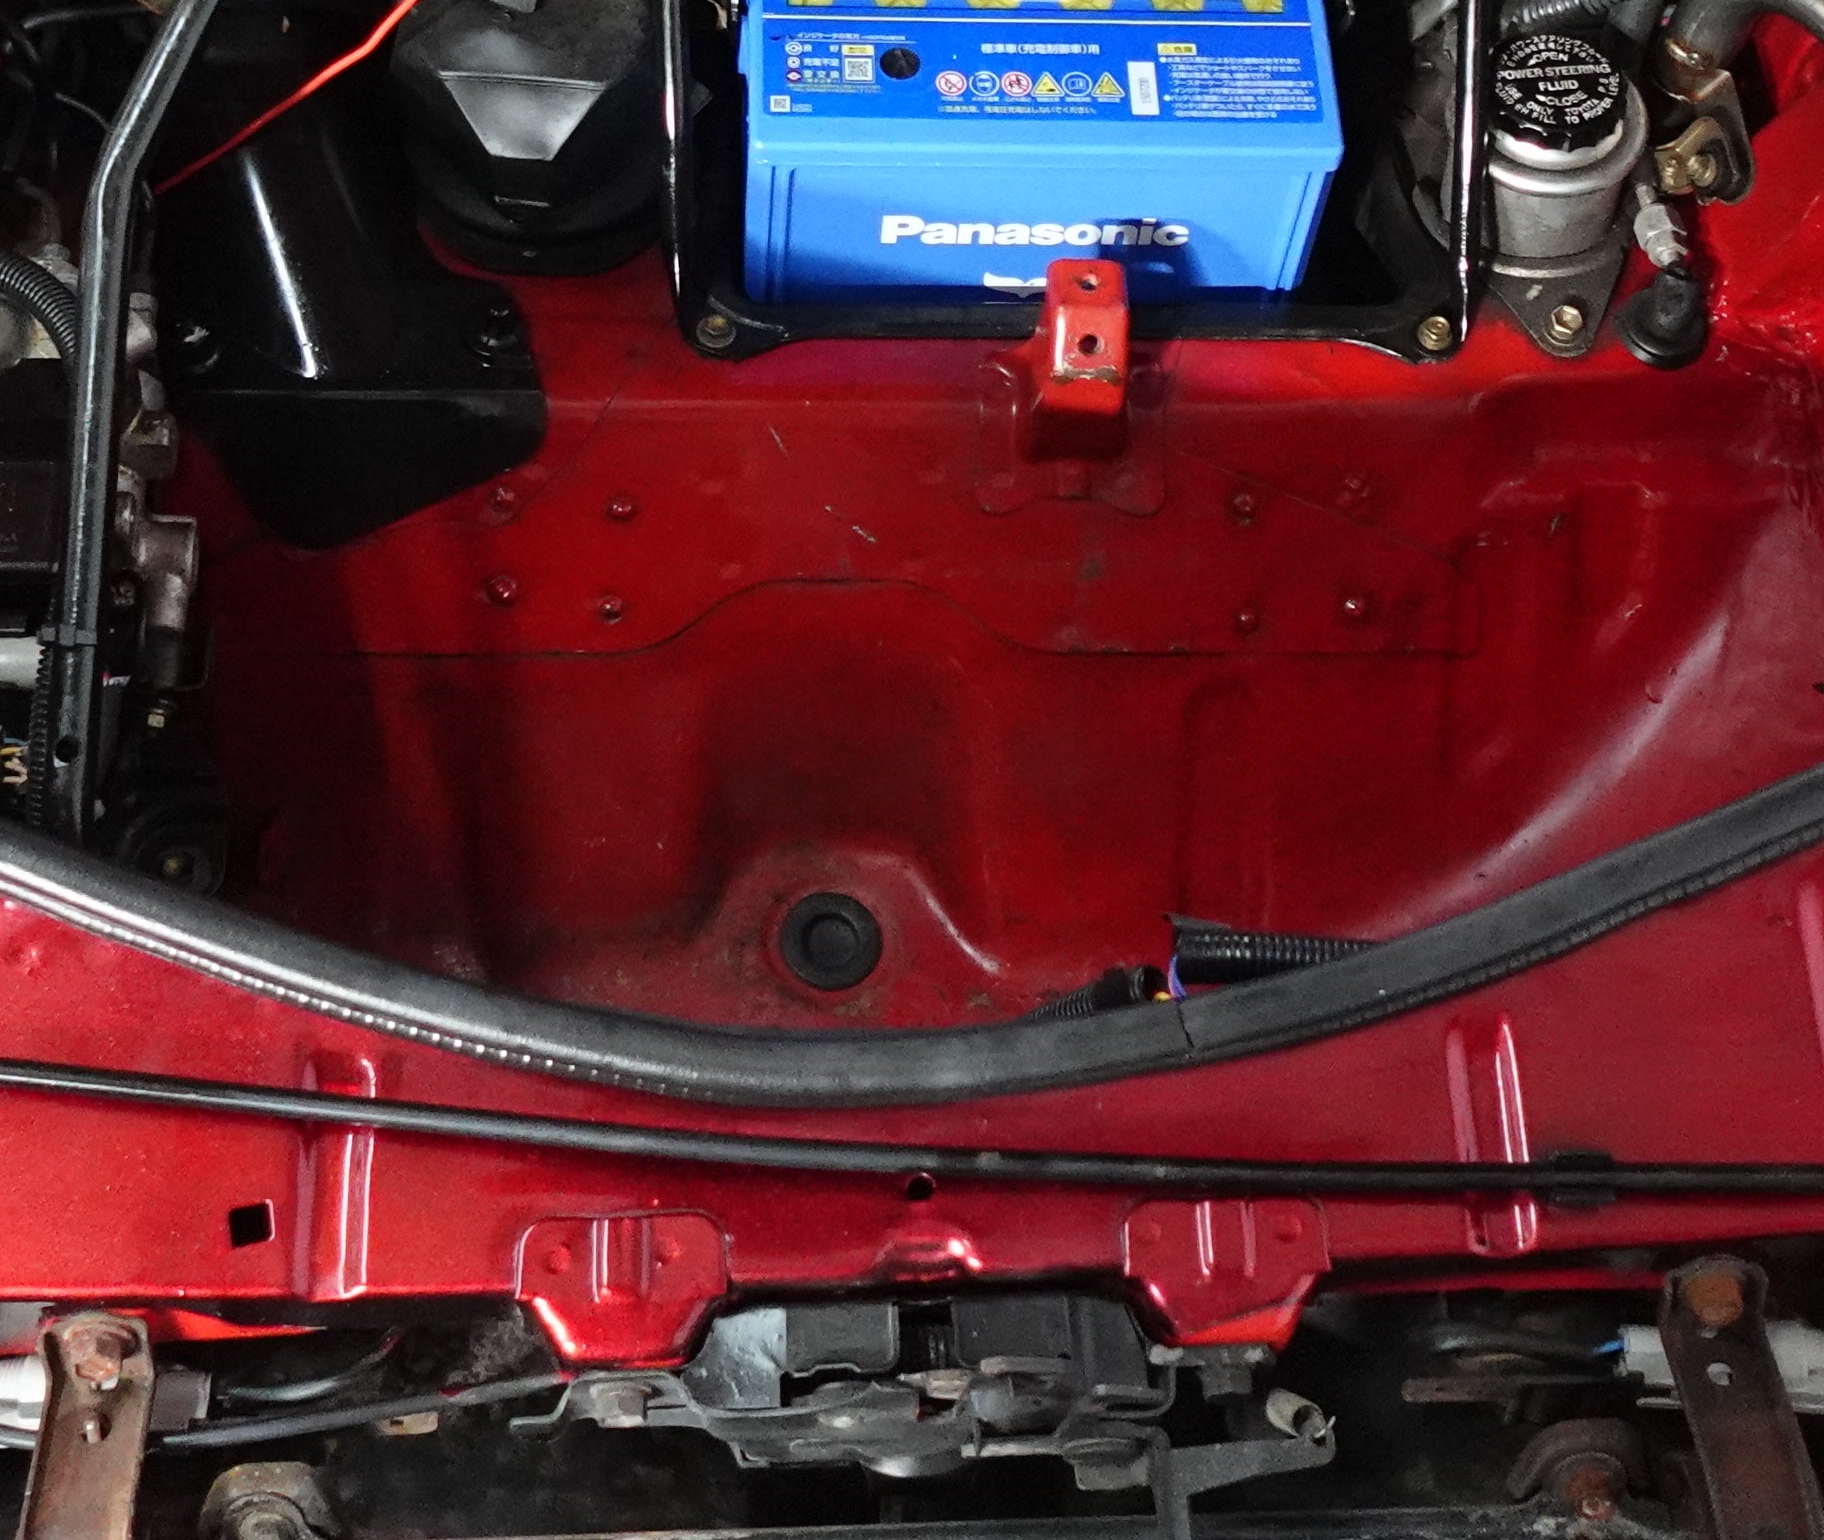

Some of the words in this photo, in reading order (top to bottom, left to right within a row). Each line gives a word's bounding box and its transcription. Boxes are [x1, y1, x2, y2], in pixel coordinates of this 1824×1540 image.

[1533, 52, 1569, 63] OPEN
[1497, 67, 1543, 80] POWER
[1545, 64, 1611, 76] STEERING
[1538, 80, 1579, 91] FLUID
[1546, 90, 1588, 106] CLOSE
[1564, 117, 1580, 125] TO
[879, 214, 1189, 247] Panasonic
